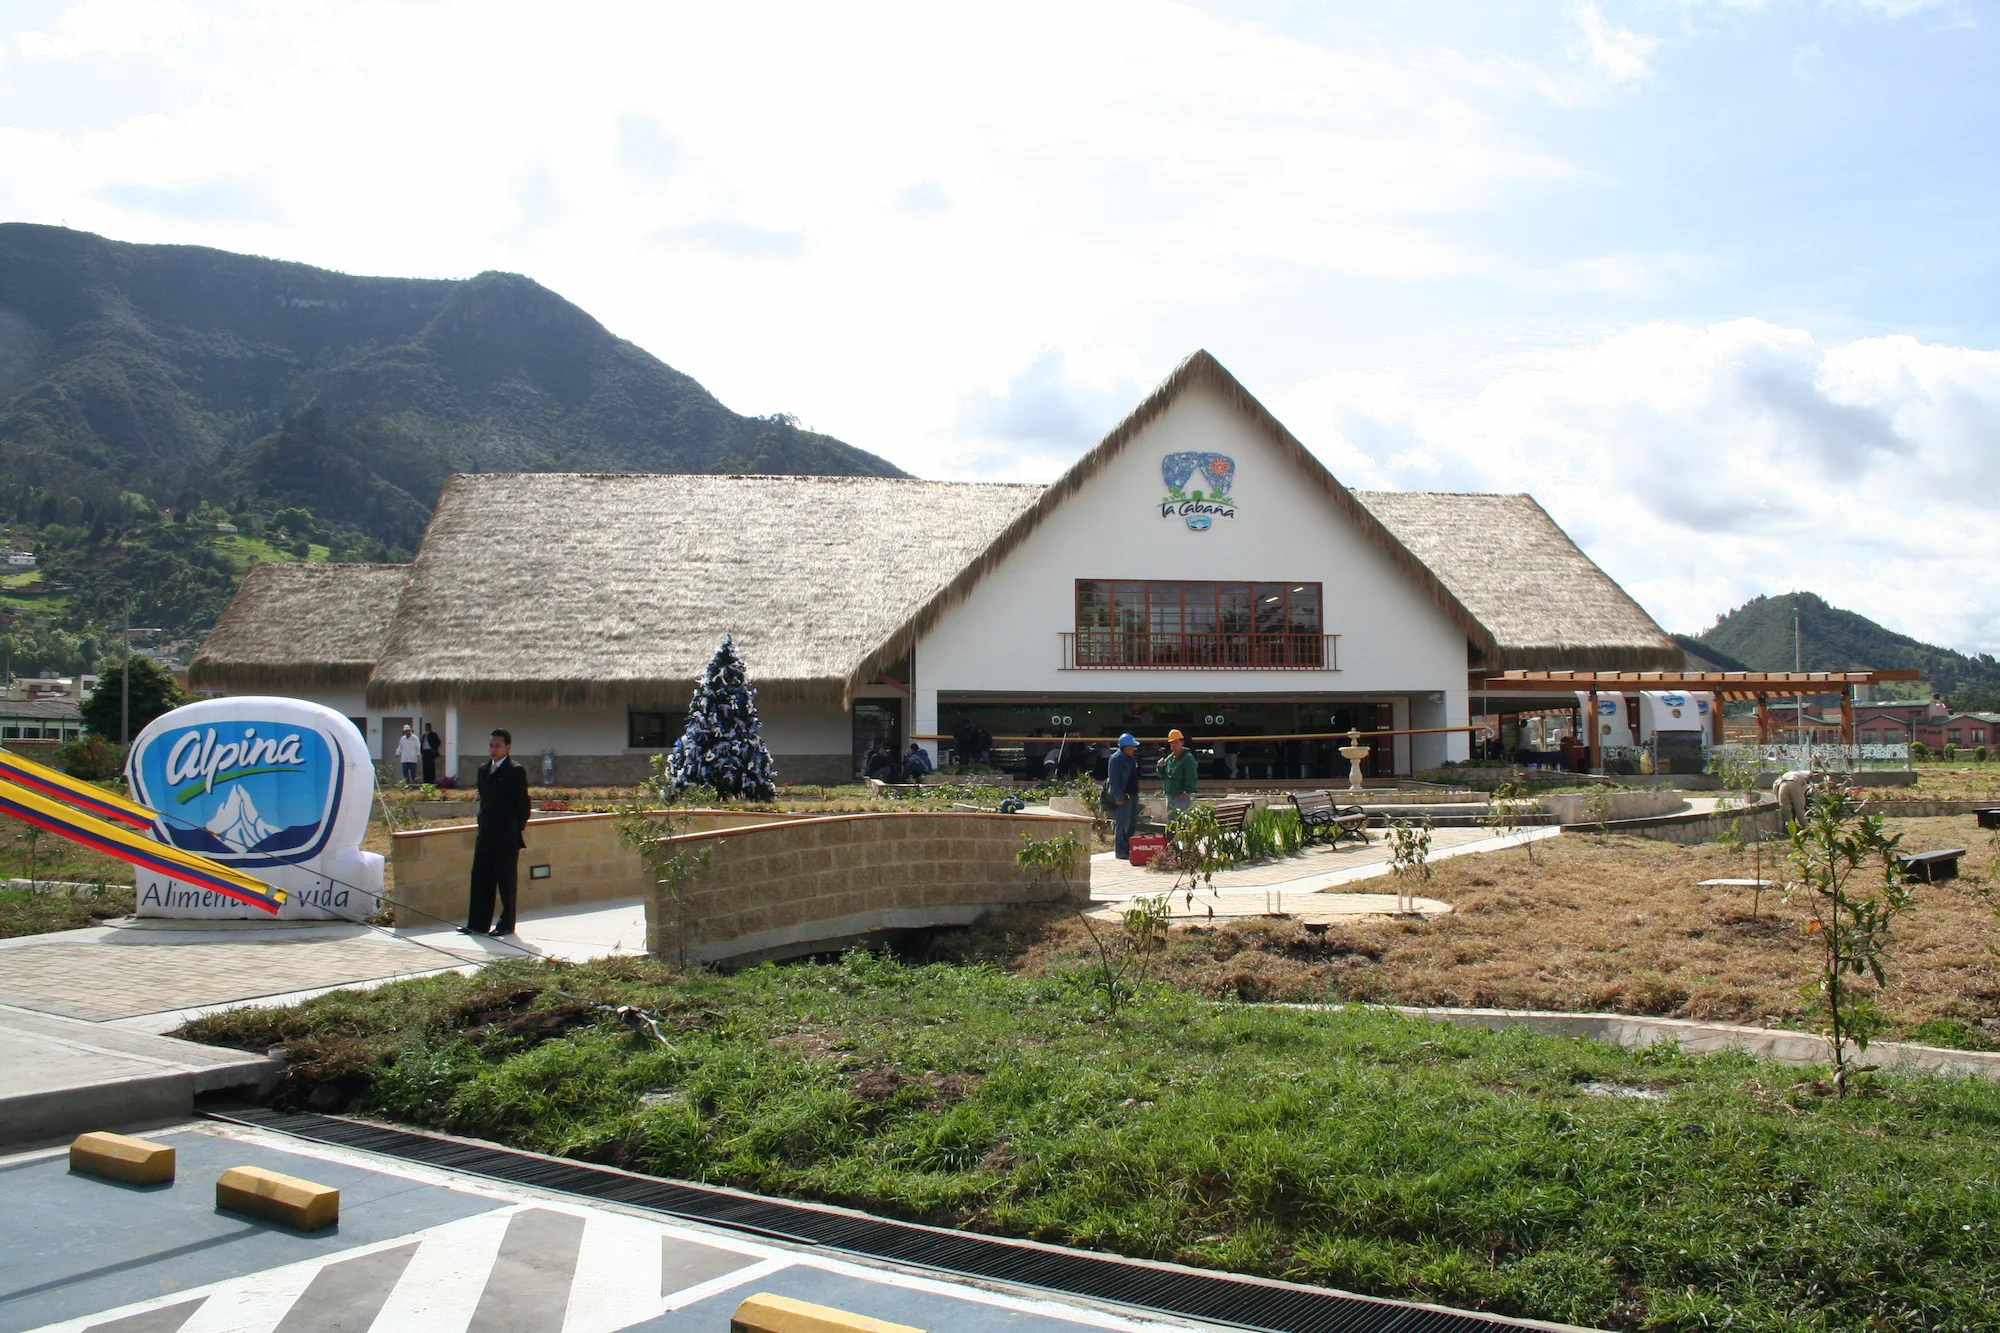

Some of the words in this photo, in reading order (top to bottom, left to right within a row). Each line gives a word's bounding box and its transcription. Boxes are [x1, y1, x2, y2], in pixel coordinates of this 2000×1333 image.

[1178, 499, 1234, 518] Cabaña
[141, 880, 251, 908] Alimen
[298, 879, 350, 908] vida
